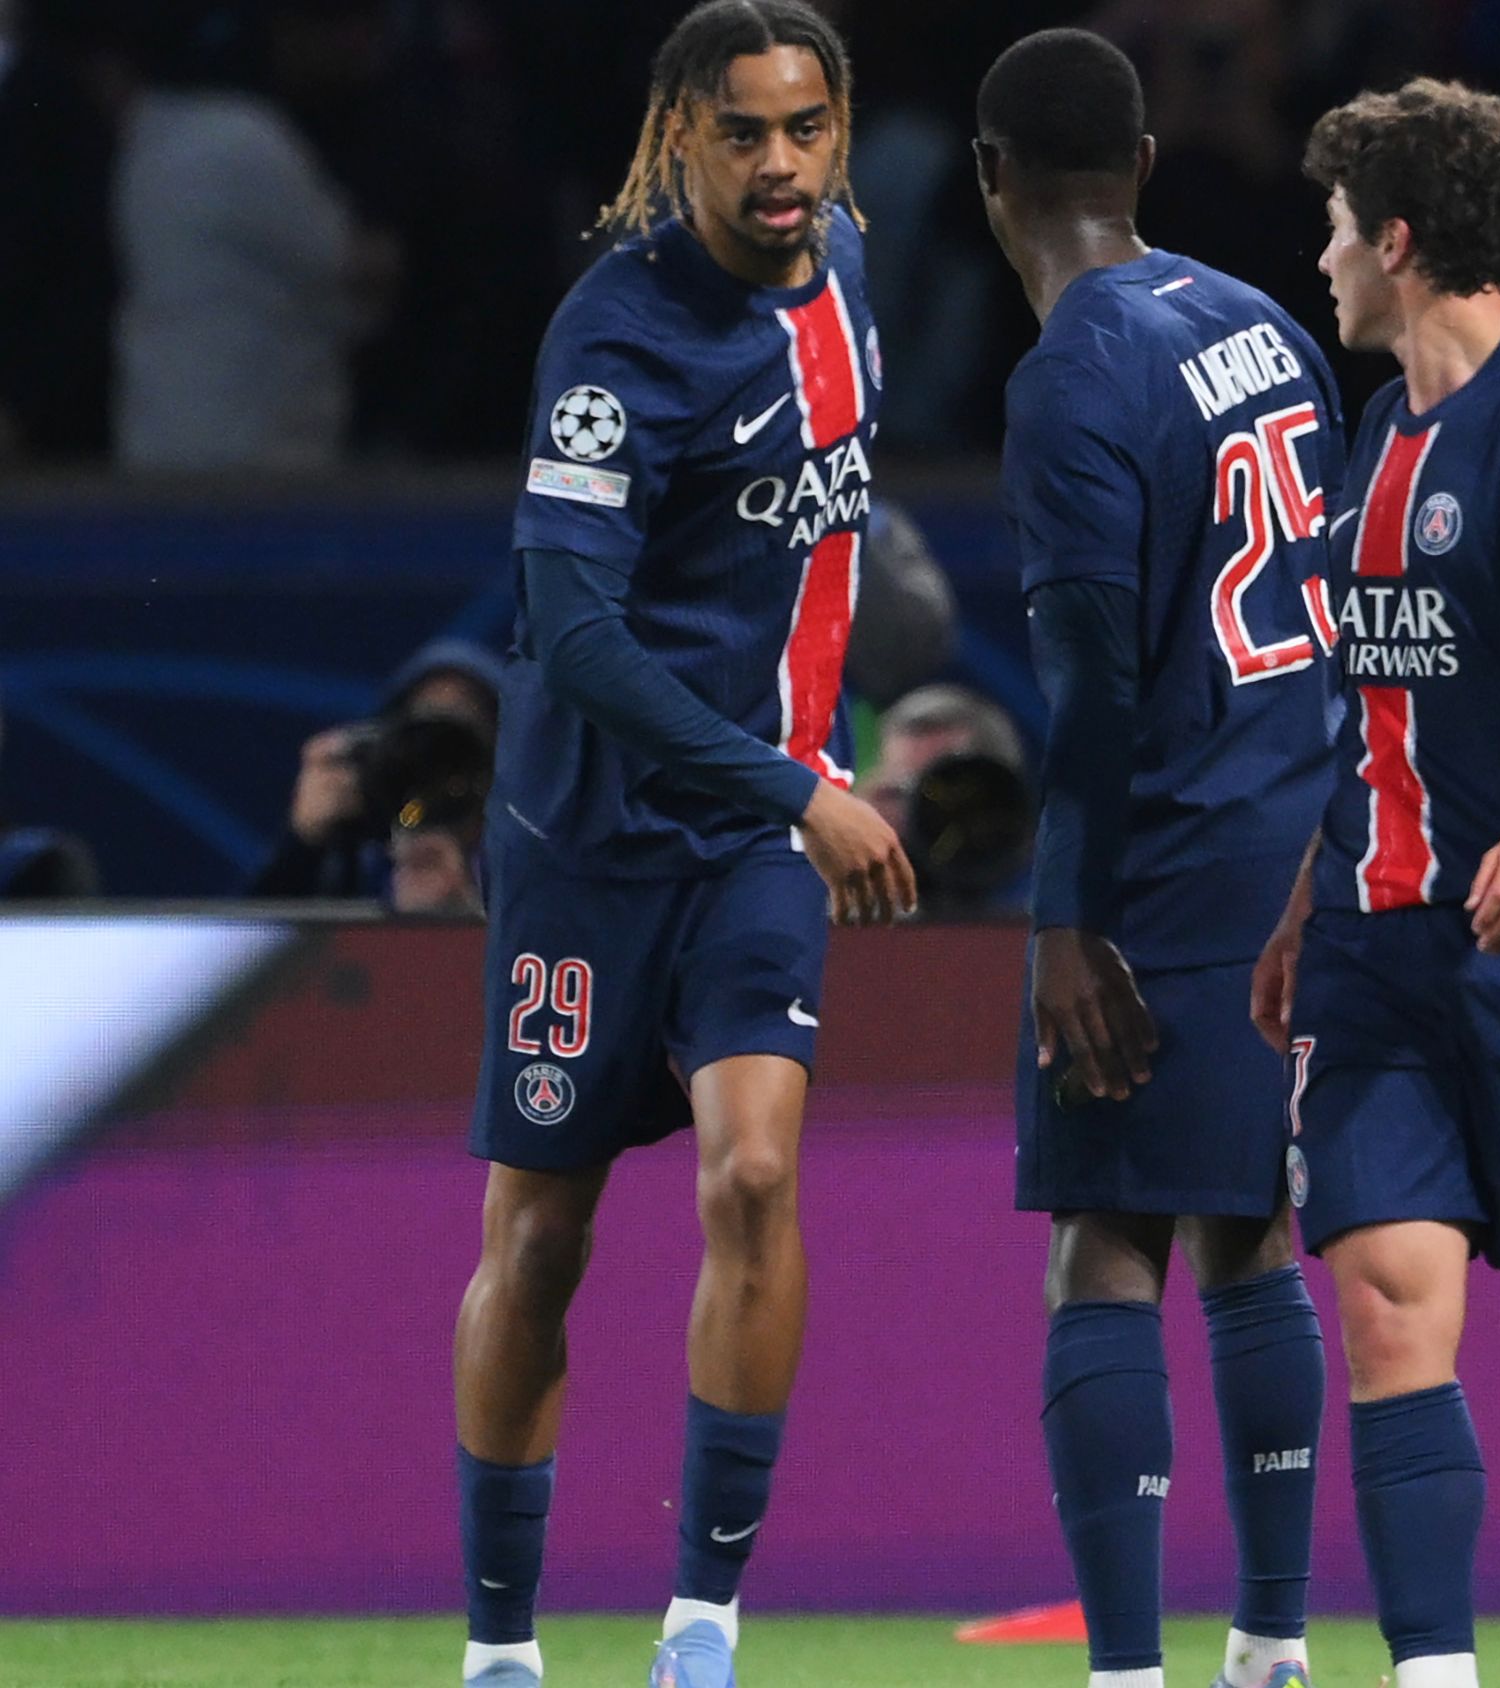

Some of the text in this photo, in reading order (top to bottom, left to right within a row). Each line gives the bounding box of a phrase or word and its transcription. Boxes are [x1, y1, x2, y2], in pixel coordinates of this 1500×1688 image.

[736, 421, 878, 527] QATA
[788, 487, 870, 549] AIWA
[1211, 401, 1340, 686] 25
[508, 952, 593, 1058] 29
[1253, 1448, 1311, 1474] PARIS
